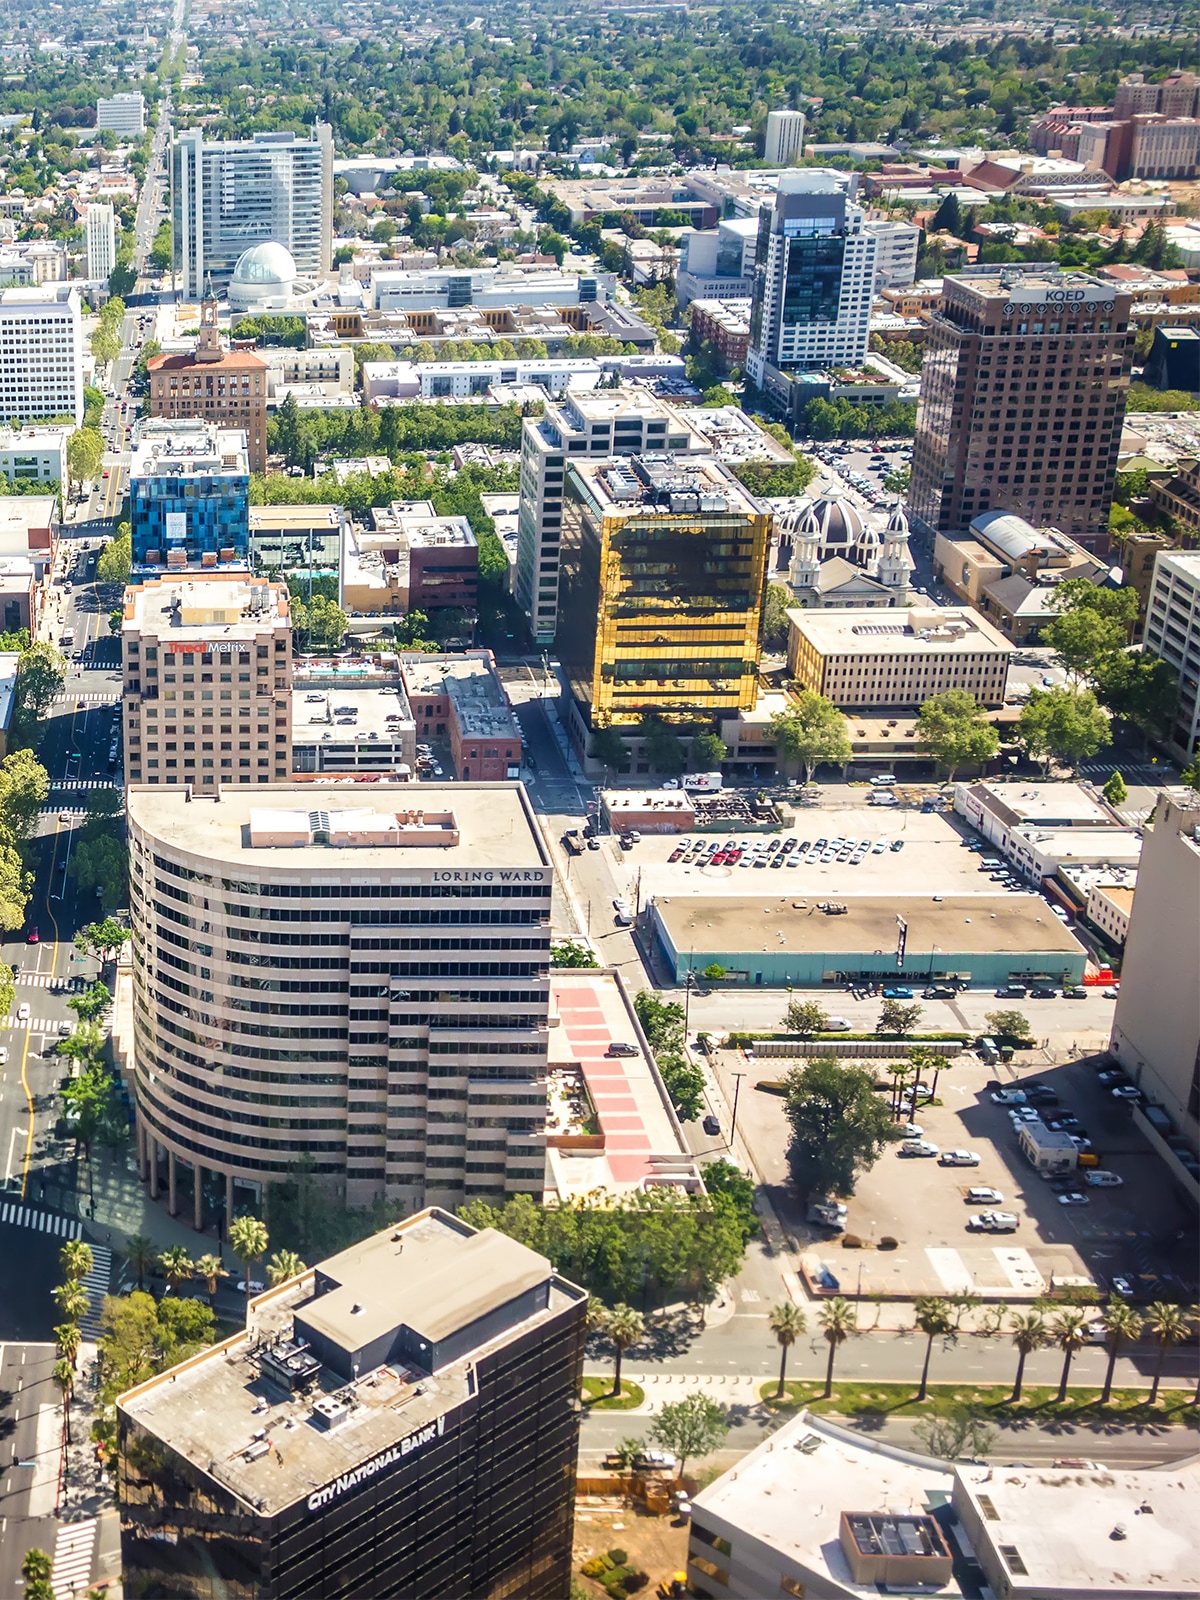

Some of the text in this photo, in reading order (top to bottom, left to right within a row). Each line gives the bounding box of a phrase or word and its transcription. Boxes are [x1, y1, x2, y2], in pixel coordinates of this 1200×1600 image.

[1045, 290, 1085, 302] KQED
[685, 778, 709, 786] FedEx
[433, 871, 544, 881] LORING WARD
[307, 1425, 437, 1511] CITY NATIONAL BANK
